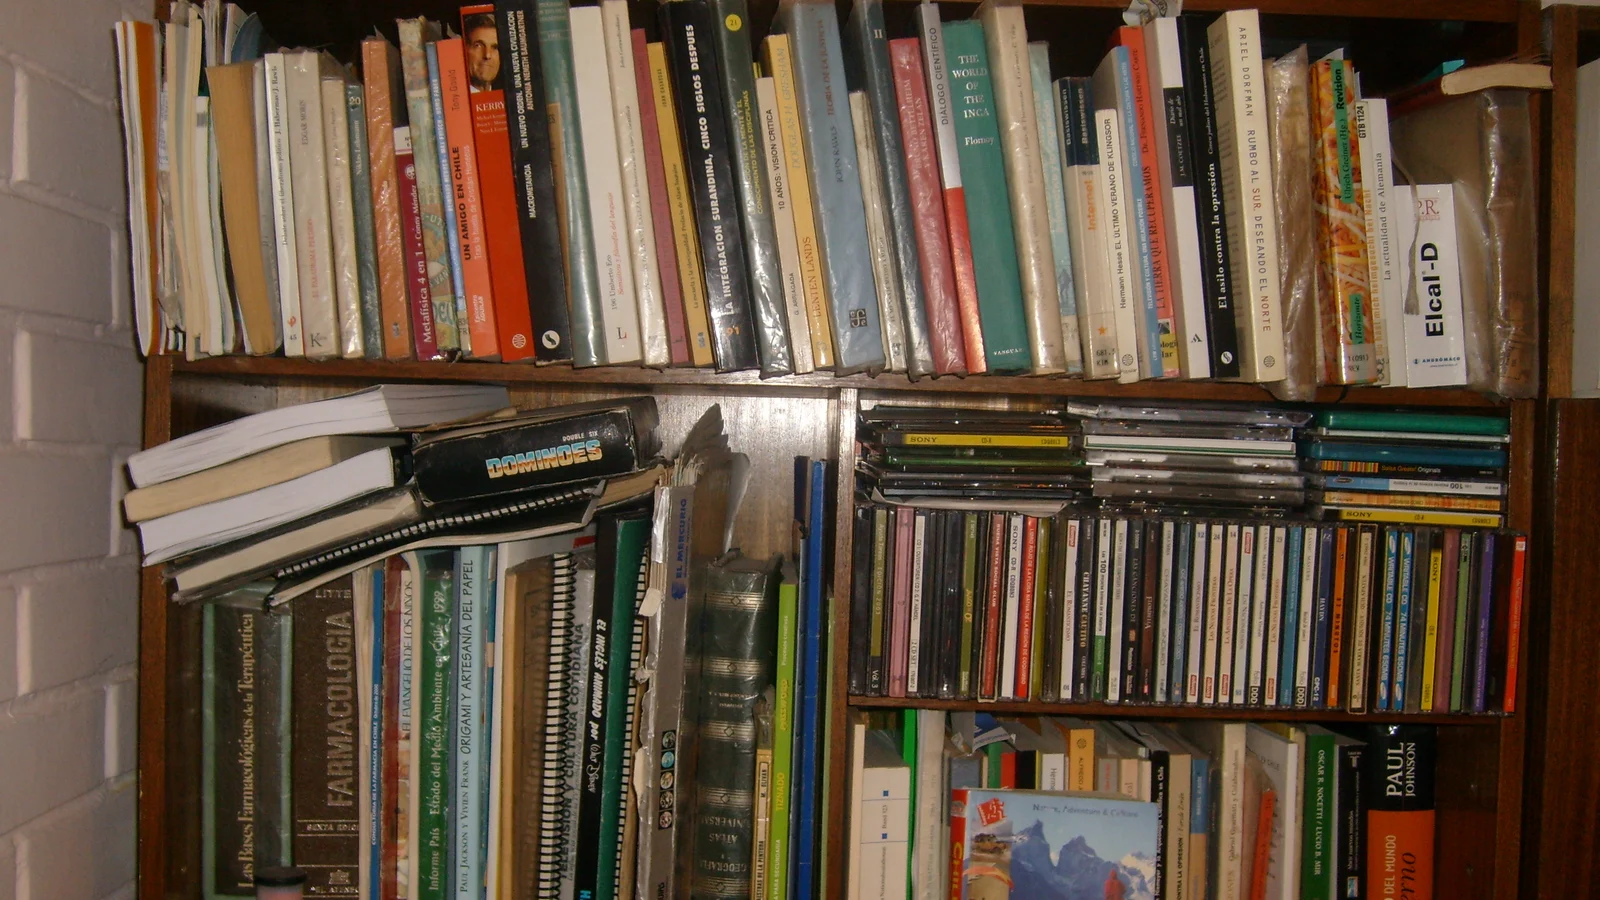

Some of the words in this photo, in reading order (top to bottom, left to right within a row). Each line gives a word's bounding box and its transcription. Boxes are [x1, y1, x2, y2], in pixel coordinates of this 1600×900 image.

[507, 11, 518, 50] CIVILIZACION
[517, 10, 529, 56] BAUMGARTNER
[685, 24, 699, 70] DESPUES
[1238, 27, 1249, 62] ARIEL
[511, 51, 520, 73] NUEVA
[523, 56, 531, 81] NEMETH
[952, 67, 988, 79] WORLD
[958, 54, 979, 65] THE
[448, 69, 458, 92] Gould
[514, 74, 522, 88] UNA
[692, 75, 705, 113] SIGLOS
[965, 81, 979, 91] OF
[1241, 67, 1254, 117] DORFMAN
[1333, 69, 1345, 110] Revision
[451, 94, 460, 111] Tony
[476, 101, 505, 112] KERRY
[516, 90, 525, 114] ORDEN.
[525, 82, 534, 110] ANTONIA
[963, 95, 984, 104] THE
[743, 90, 753, 133] DISCIPLINAS
[963, 108, 990, 119] INCA
[1077, 88, 1089, 145] Basiswissen
[1356, 105, 1365, 122] 1124
[518, 115, 528, 138] NUEVO
[698, 117, 710, 150] CINCO
[765, 109, 776, 142] CRITICA
[1103, 118, 1113, 159] KLINGSOR
[1339, 118, 1350, 141] (Hg.)
[1358, 123, 1367, 139] GTB
[521, 137, 529, 149] UN
[748, 134, 756, 148] LAS
[750, 149, 756, 158] DE
[830, 126, 841, 157] RAWLS
[1246, 129, 1258, 166] RUMBO
[452, 147, 462, 181] CHILE
[771, 144, 780, 171] VISION
[833, 158, 844, 182] JOHN
[1107, 162, 1114, 172] DE
[1341, 141, 1350, 172] Greiner
[704, 153, 721, 220] SURANDINA,
[752, 159, 763, 214] CONOCIMIENTO
[774, 173, 784, 199] AÑOS:
[1208, 163, 1220, 212] opresión
[1250, 170, 1260, 183] AL
[1341, 172, 1352, 200] Ulrich
[1375, 152, 1386, 198] Alemania
[410, 184, 419, 214] Méndez
[457, 184, 465, 199] EN
[524, 164, 537, 218] MACROMETANOIA
[1108, 174, 1118, 207] VERANO
[1141, 165, 1158, 235] RECUPERAMOS
[778, 201, 785, 210] 10
[1084, 180, 1097, 230] Internet
[1378, 200, 1386, 213] de
[414, 216, 422, 240] Conny
[459, 203, 470, 240] AMIGO
[1111, 208, 1120, 238] ÚLTIMO
[1211, 214, 1220, 224] la
[462, 244, 471, 261] UN
[803, 236, 815, 272] LANDS
[1114, 240, 1121, 250] EL
[1150, 238, 1161, 257] QUE
[1213, 228, 1223, 264] contra
[1254, 215, 1268, 275] DESEANDO
[1379, 216, 1390, 266] actualidad
[417, 261, 424, 273] en
[714, 225, 732, 297] INTEGRACION
[1115, 251, 1123, 275] Hesse
[607, 268, 616, 297] Umberto
[1152, 259, 1164, 293] TIERRA
[1215, 266, 1225, 293] asilo
[1259, 278, 1268, 292] EL
[1384, 269, 1391, 281] La
[809, 275, 822, 318] LENTEN
[1117, 276, 1127, 309] Hermann
[1156, 297, 1166, 309] LA
[1218, 296, 1227, 309] El
[418, 287, 432, 343] Metafísica
[724, 302, 735, 316] LA
[1261, 295, 1271, 332] NORTE
[1354, 296, 1363, 339] Horizonte
[562, 433, 585, 442] DOUBLE
[909, 435, 937, 443] SONY
[485, 439, 603, 479] DOMINOES
[1345, 511, 1373, 519] SONY
[675, 499, 687, 561] MERCURIO
[1011, 525, 1019, 551] SONY
[461, 559, 473, 595] PAPEL
[675, 564, 685, 579] EL
[1386, 556, 1395, 590] WRITABLE
[1401, 558, 1411, 592] WRITABLE
[1431, 556, 1439, 583] SONY
[433, 589, 444, 613] 1999
[461, 600, 473, 621] DEL
[1318, 597, 1326, 621] HAYDN
[1385, 593, 1393, 604] CD
[1400, 594, 1408, 605] CD
[596, 620, 607, 631] EL
[1385, 610, 1392, 621] 74
[1400, 611, 1407, 621] 74
[431, 624, 443, 652] Chile
[594, 632, 608, 667] INGLÉS
[1383, 621, 1391, 654] MINUTES
[1398, 622, 1406, 655] MINUTES
[236, 613, 257, 693] Terapéutica
[434, 655, 443, 668] en
[458, 625, 472, 691] ARTESANÍA
[1381, 655, 1389, 681] 650MB
[1396, 656, 1404, 682] 650MB
[243, 692, 254, 702] la
[431, 672, 443, 723] Ambiente
[461, 694, 472, 702] Y
[591, 672, 604, 718] ANIMADO
[1313, 676, 1321, 702] CPC-12
[243, 703, 254, 716] de
[326, 611, 354, 806] FARMACOLOGIA
[430, 726, 441, 759] Medio
[459, 704, 471, 755] ORIGAMI
[588, 721, 601, 740] por
[236, 718, 257, 822] Farmacológicas
[430, 762, 441, 778] del
[460, 760, 469, 788] FRANK
[1316, 749, 1326, 775] OSCAR
[1385, 742, 1404, 797] PAUL
[1405, 742, 1417, 797] JOHNSON
[1316, 777, 1324, 785] R.
[430, 781, 441, 815] Estado
[460, 791, 469, 820] VIVIEN
[1315, 786, 1325, 819] NOCETTI
[237, 823, 254, 861] Bases
[427, 827, 440, 848] País
[459, 831, 470, 869] JACKSON
[1315, 826, 1323, 850] LUCIO
[1384, 834, 1397, 872] MUNDO
[236, 862, 254, 888] Las
[427, 851, 440, 891] Informe
[1313, 860, 1321, 875] MIR
[459, 871, 469, 893] PAUL
[1383, 875, 1396, 894] DEL
